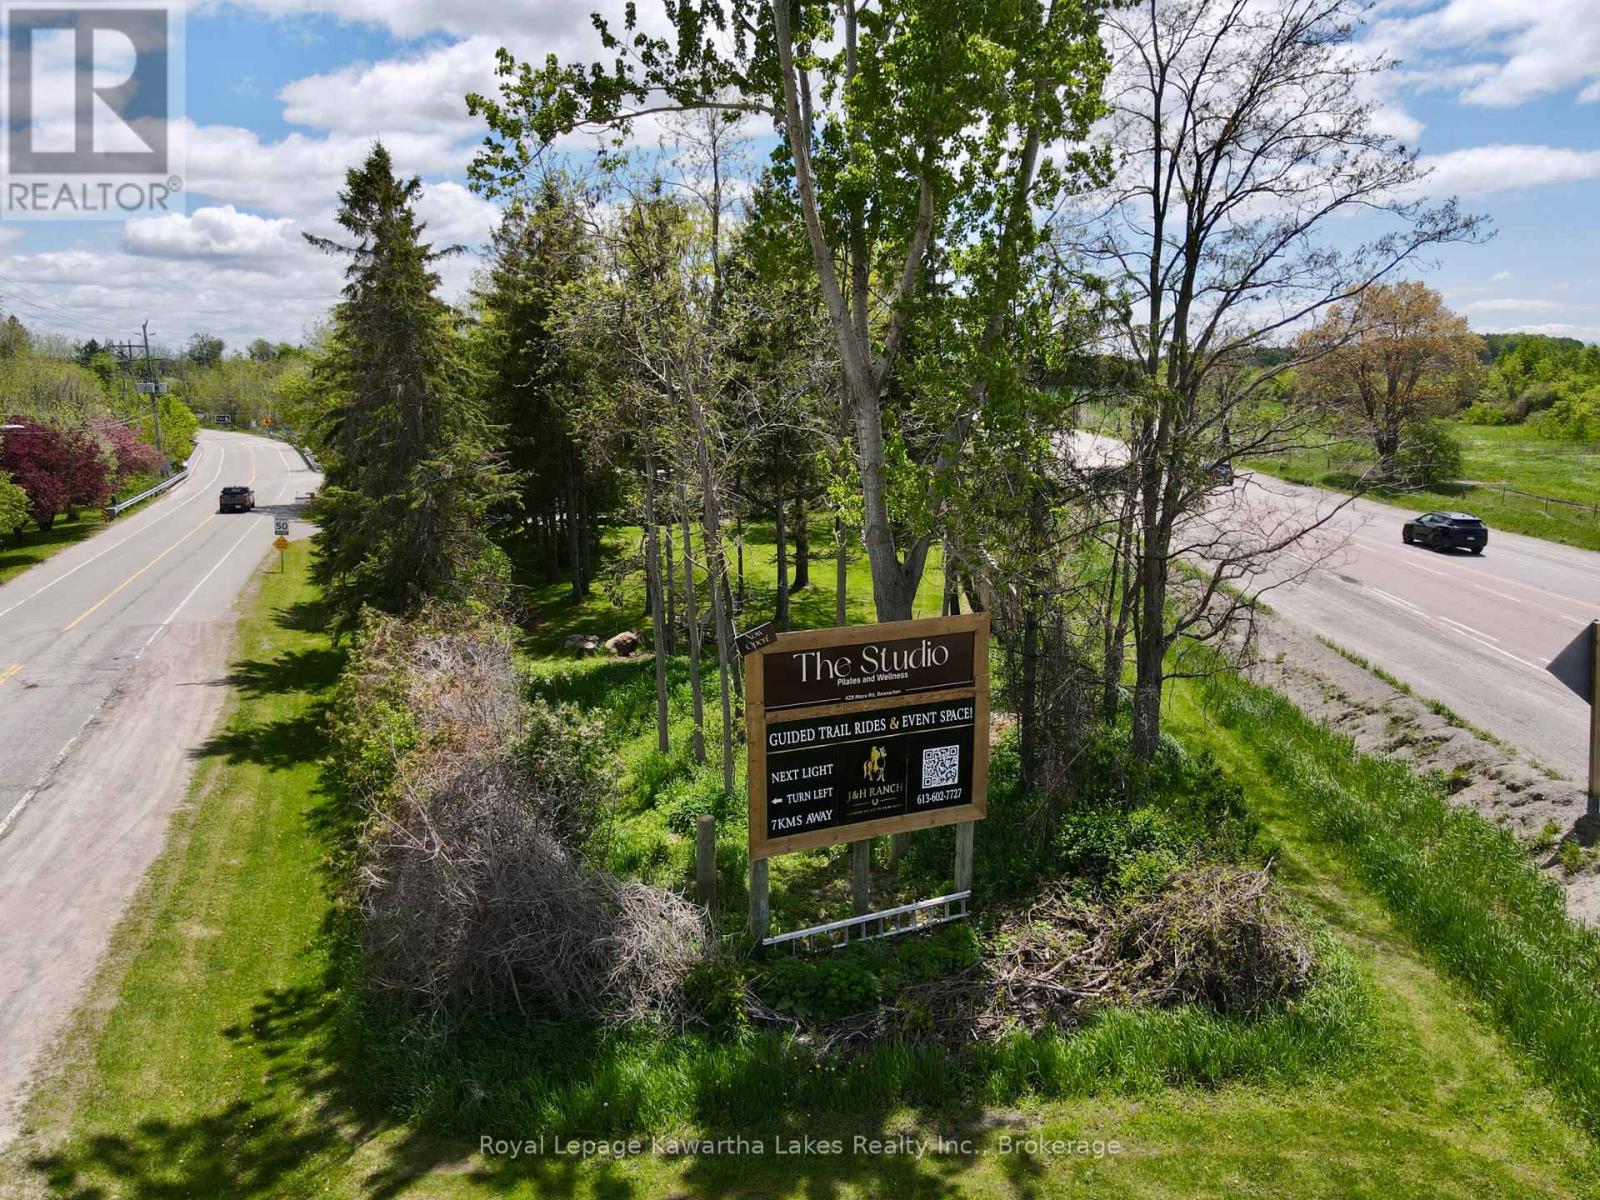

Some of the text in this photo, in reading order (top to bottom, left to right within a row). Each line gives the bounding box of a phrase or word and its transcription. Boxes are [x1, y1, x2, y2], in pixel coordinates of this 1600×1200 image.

[276, 522, 288, 530] 50
[793, 639, 949, 682] The Studio
[837, 671, 909, 687] Pilates and Wellness
[769, 706, 973, 747] GUIDED TRAIL RIDES & EVENT SPACE!
[771, 763, 834, 784] NEXT LIGHT
[786, 787, 834, 804] TURN LEFT
[869, 782, 904, 798] RANCH
[916, 787, 962, 805] 613-602-7727
[771, 814, 803, 831] 7KMS
[805, 809, 833, 825] AWAY
